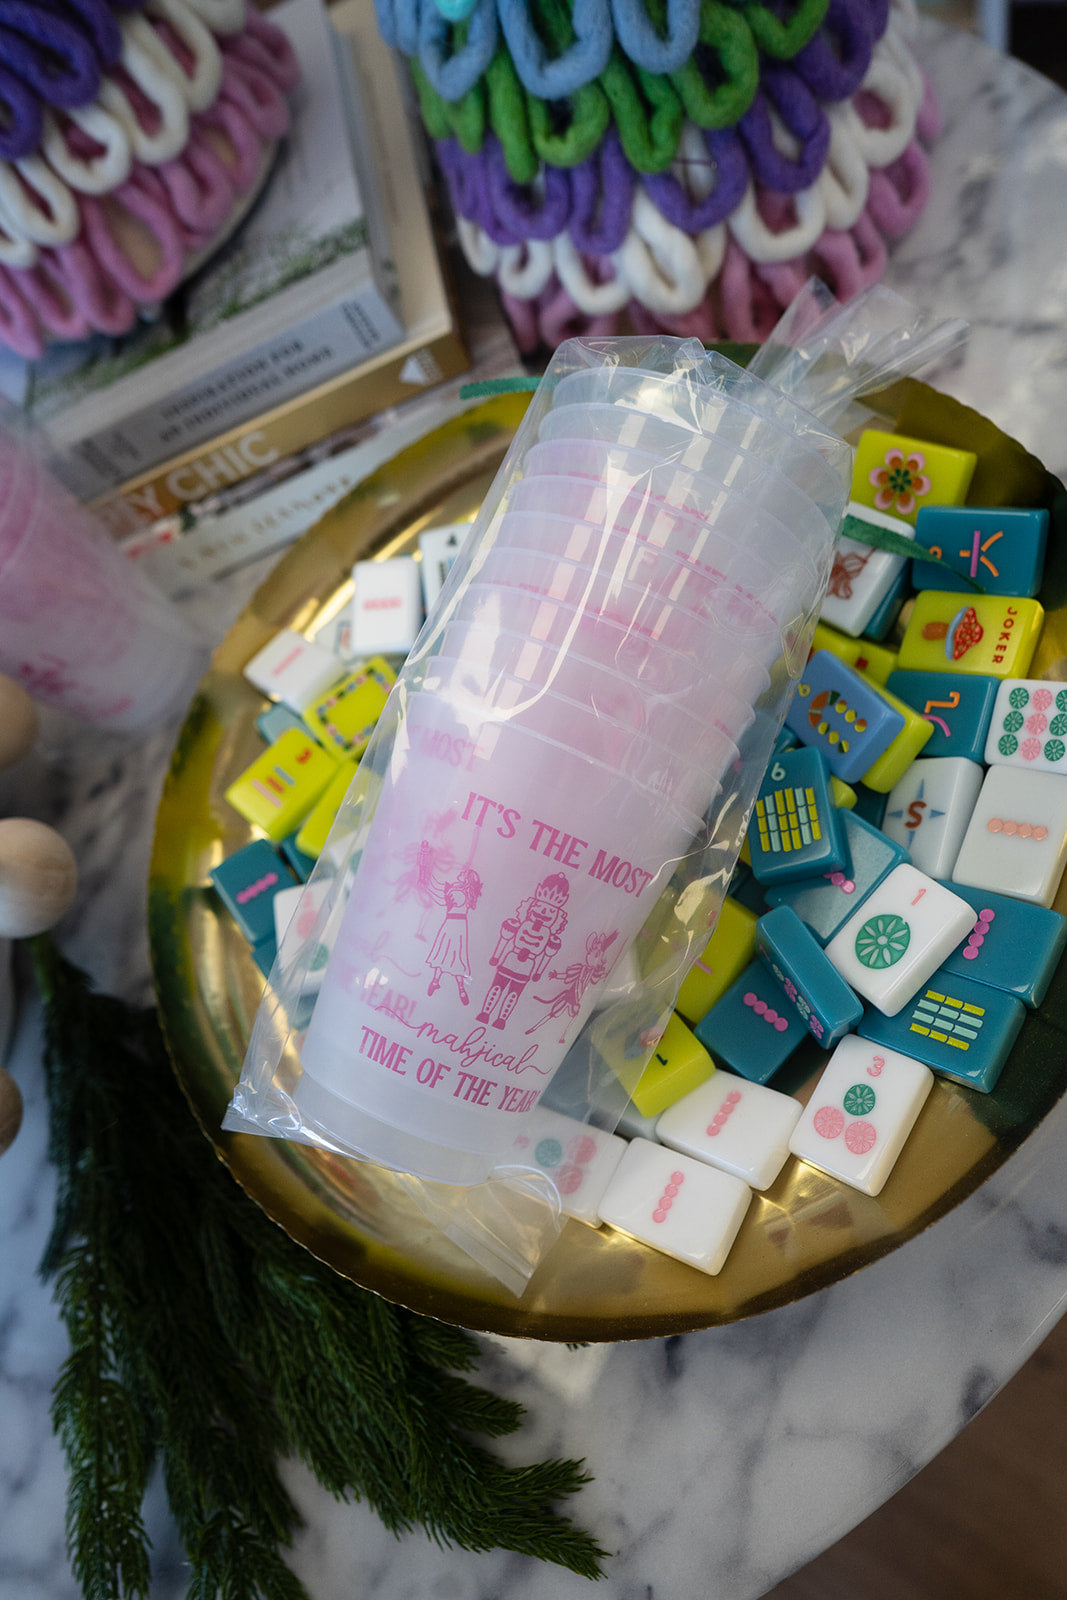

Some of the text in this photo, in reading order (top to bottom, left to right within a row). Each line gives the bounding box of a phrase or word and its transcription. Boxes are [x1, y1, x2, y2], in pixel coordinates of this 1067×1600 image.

[164, 430, 280, 502] CHIC
[991, 606, 1019, 665] JOKER
[771, 761, 786, 781] 6
[904, 800, 927, 829] S
[460, 790, 656, 899] IT'S THE MOST
[910, 888, 927, 906] 1
[358, 1025, 413, 1077] TIME
[415, 1057, 452, 1089] OF
[452, 1070, 498, 1107] THE
[374, 1004, 553, 1076] mahjical
[866, 1055, 886, 1078] 3
